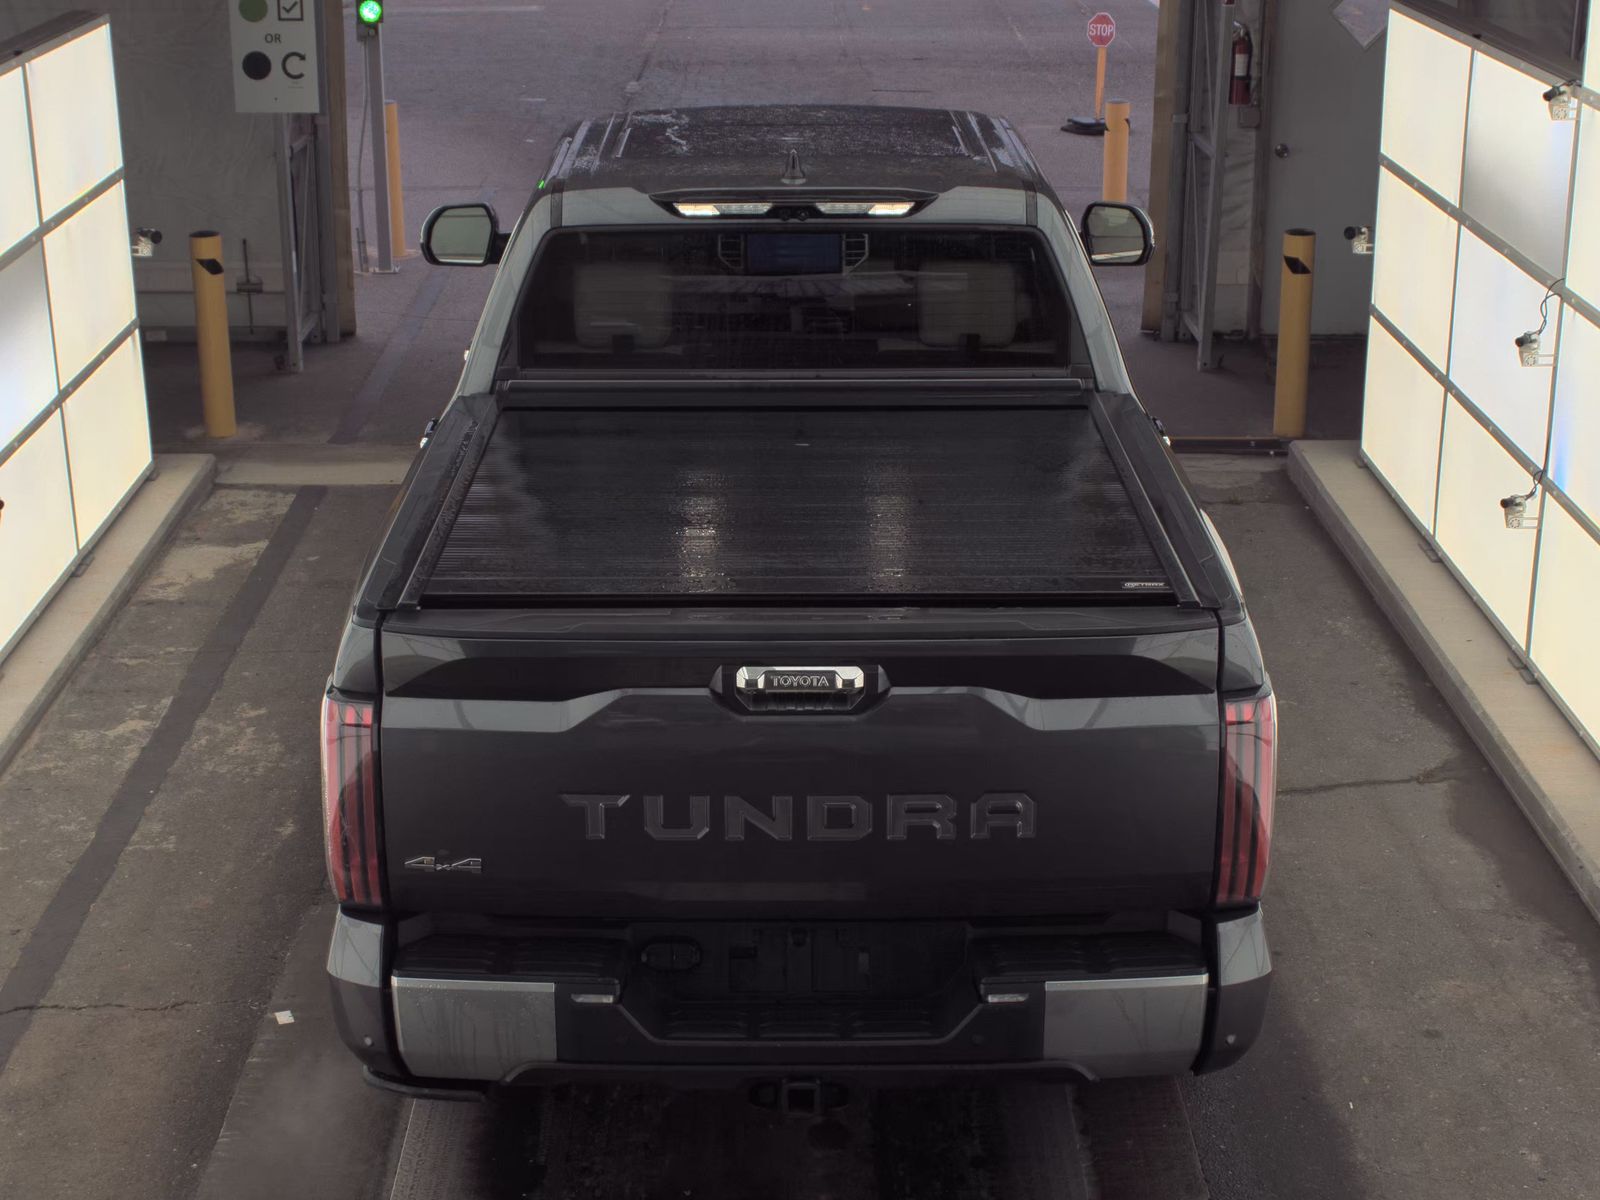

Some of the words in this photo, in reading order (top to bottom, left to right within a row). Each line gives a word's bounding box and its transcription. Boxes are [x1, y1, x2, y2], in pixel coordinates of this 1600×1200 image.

[1090, 24, 1113, 36] STOP
[264, 33, 282, 44] OR
[770, 675, 829, 687] TOYOTA
[560, 791, 1037, 841] TUNDRA
